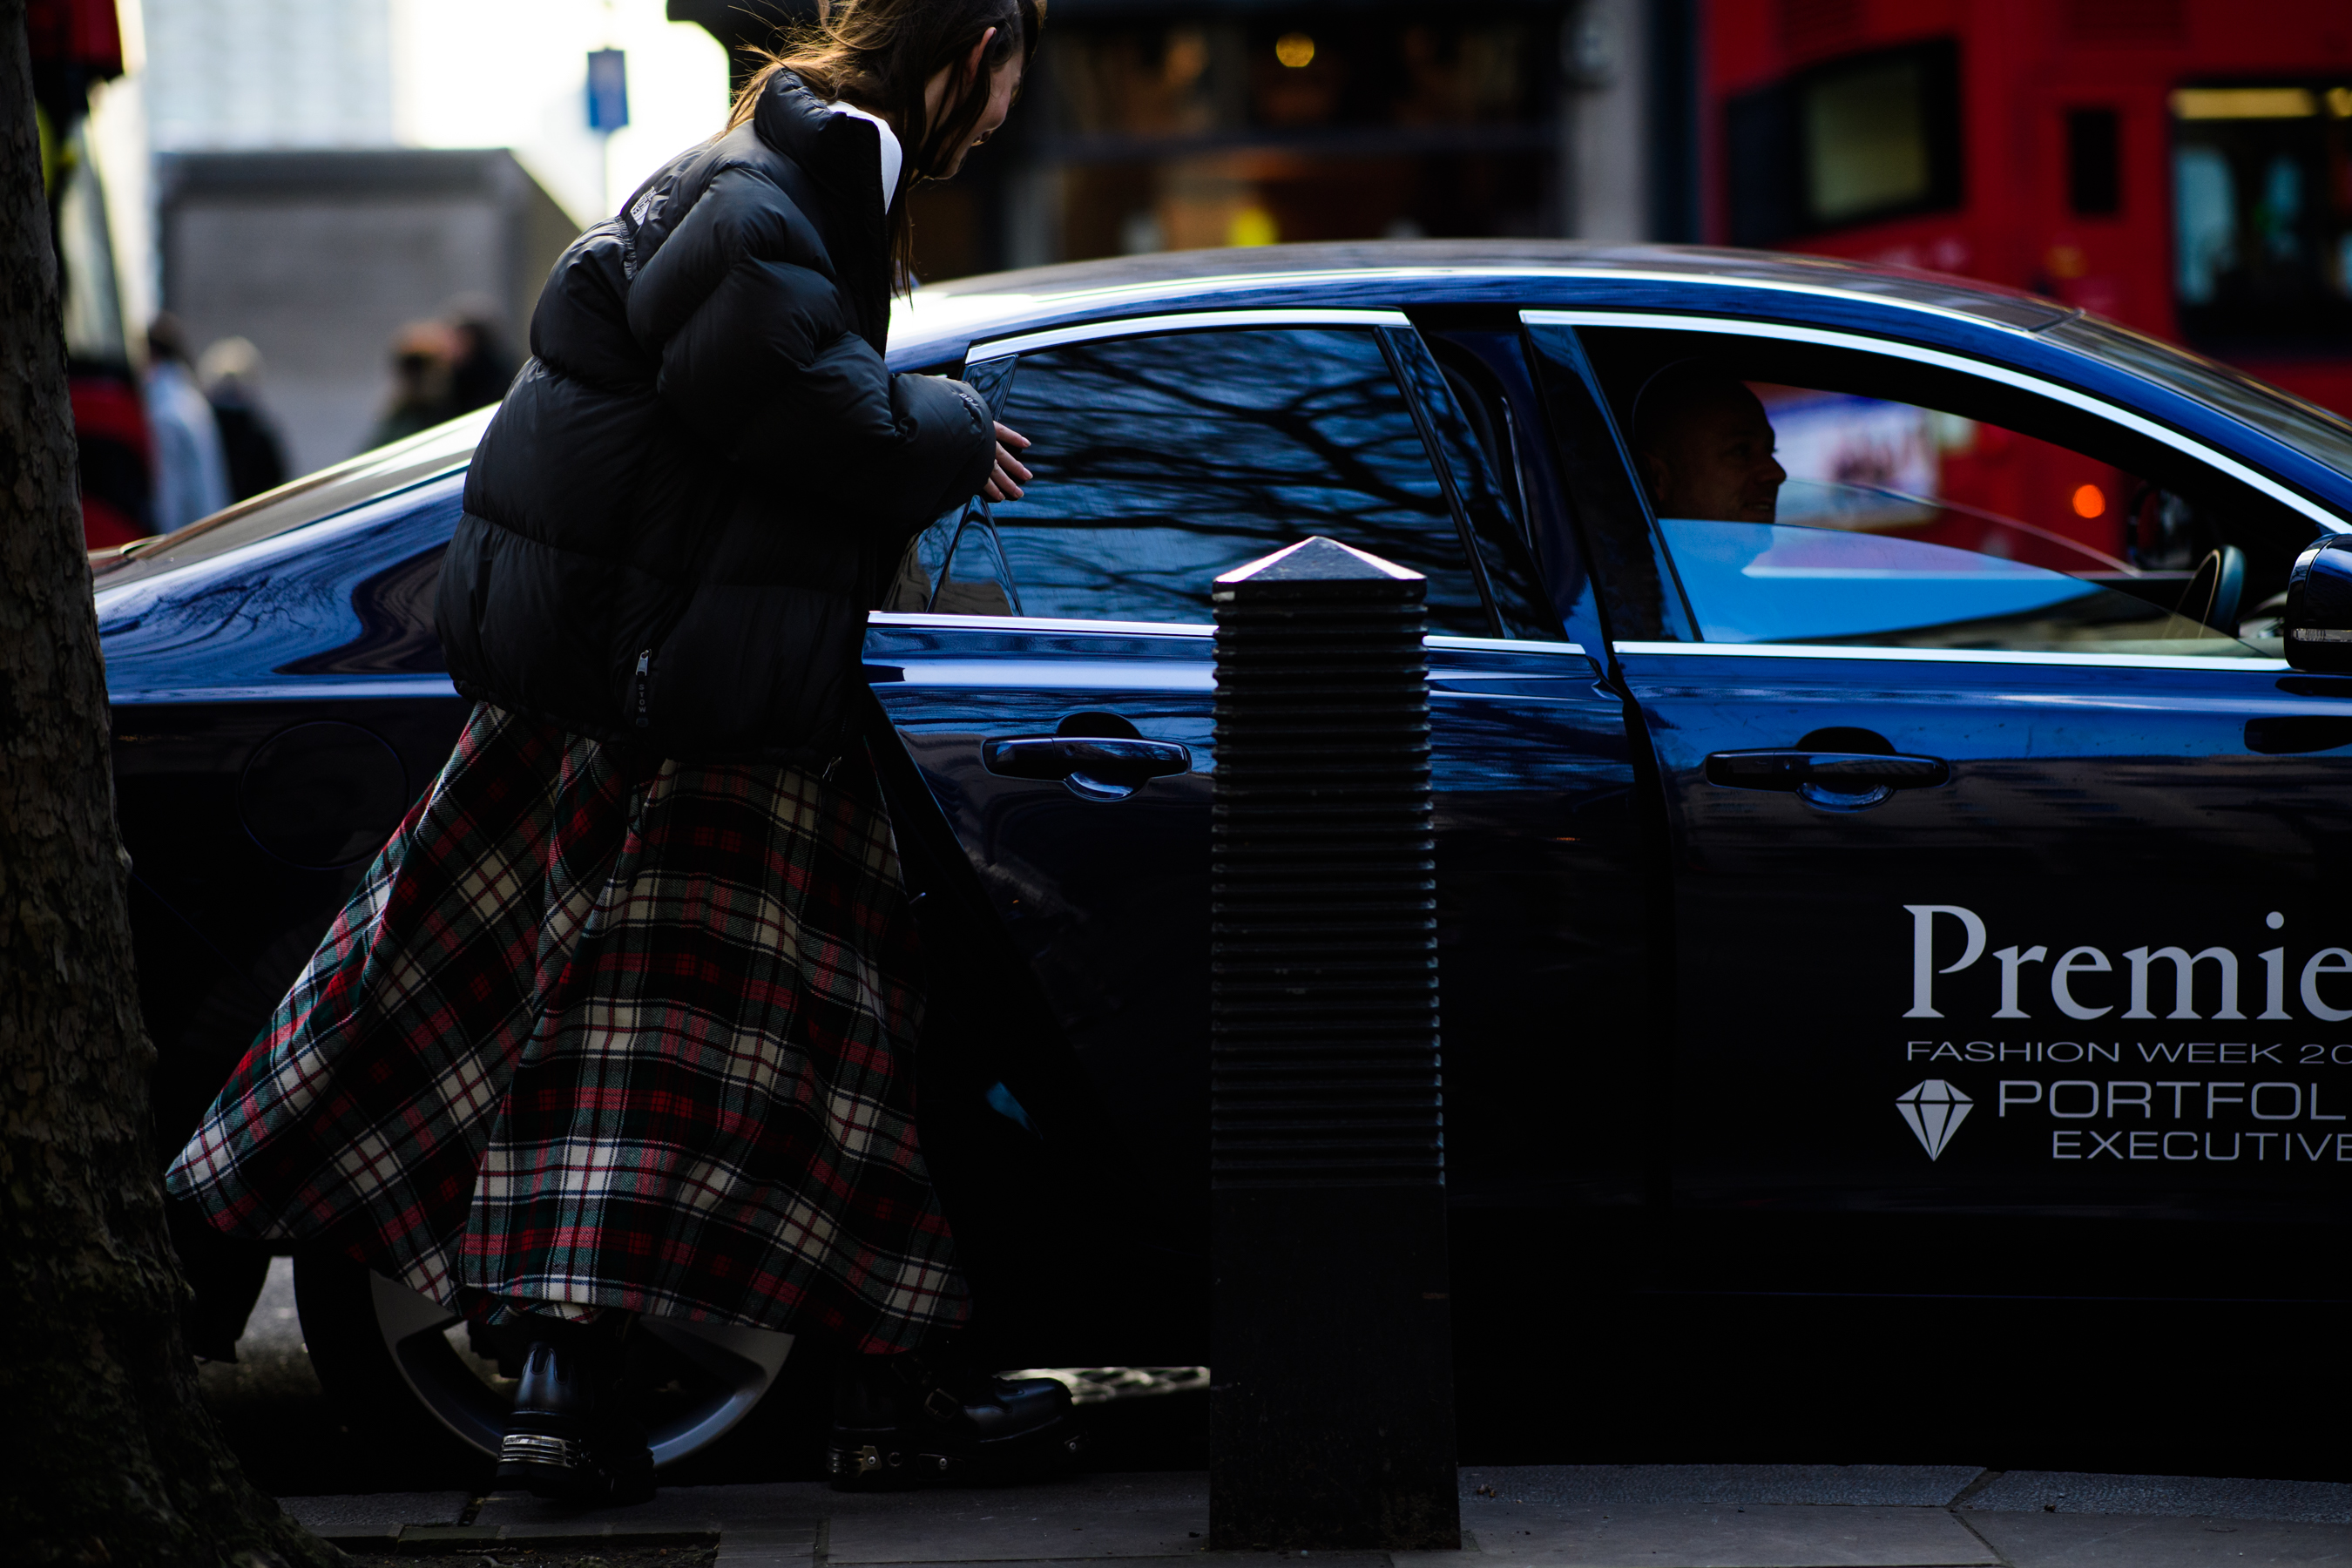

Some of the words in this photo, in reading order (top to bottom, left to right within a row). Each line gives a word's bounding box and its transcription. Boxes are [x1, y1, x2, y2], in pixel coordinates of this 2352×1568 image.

[638, 683, 647, 713] STOW
[1903, 904, 2352, 1022] Premie
[1907, 1041, 2119, 1063] FASHION
[2137, 1042, 2282, 1064] WEEK
[1999, 1080, 2347, 1120] PORTFOL
